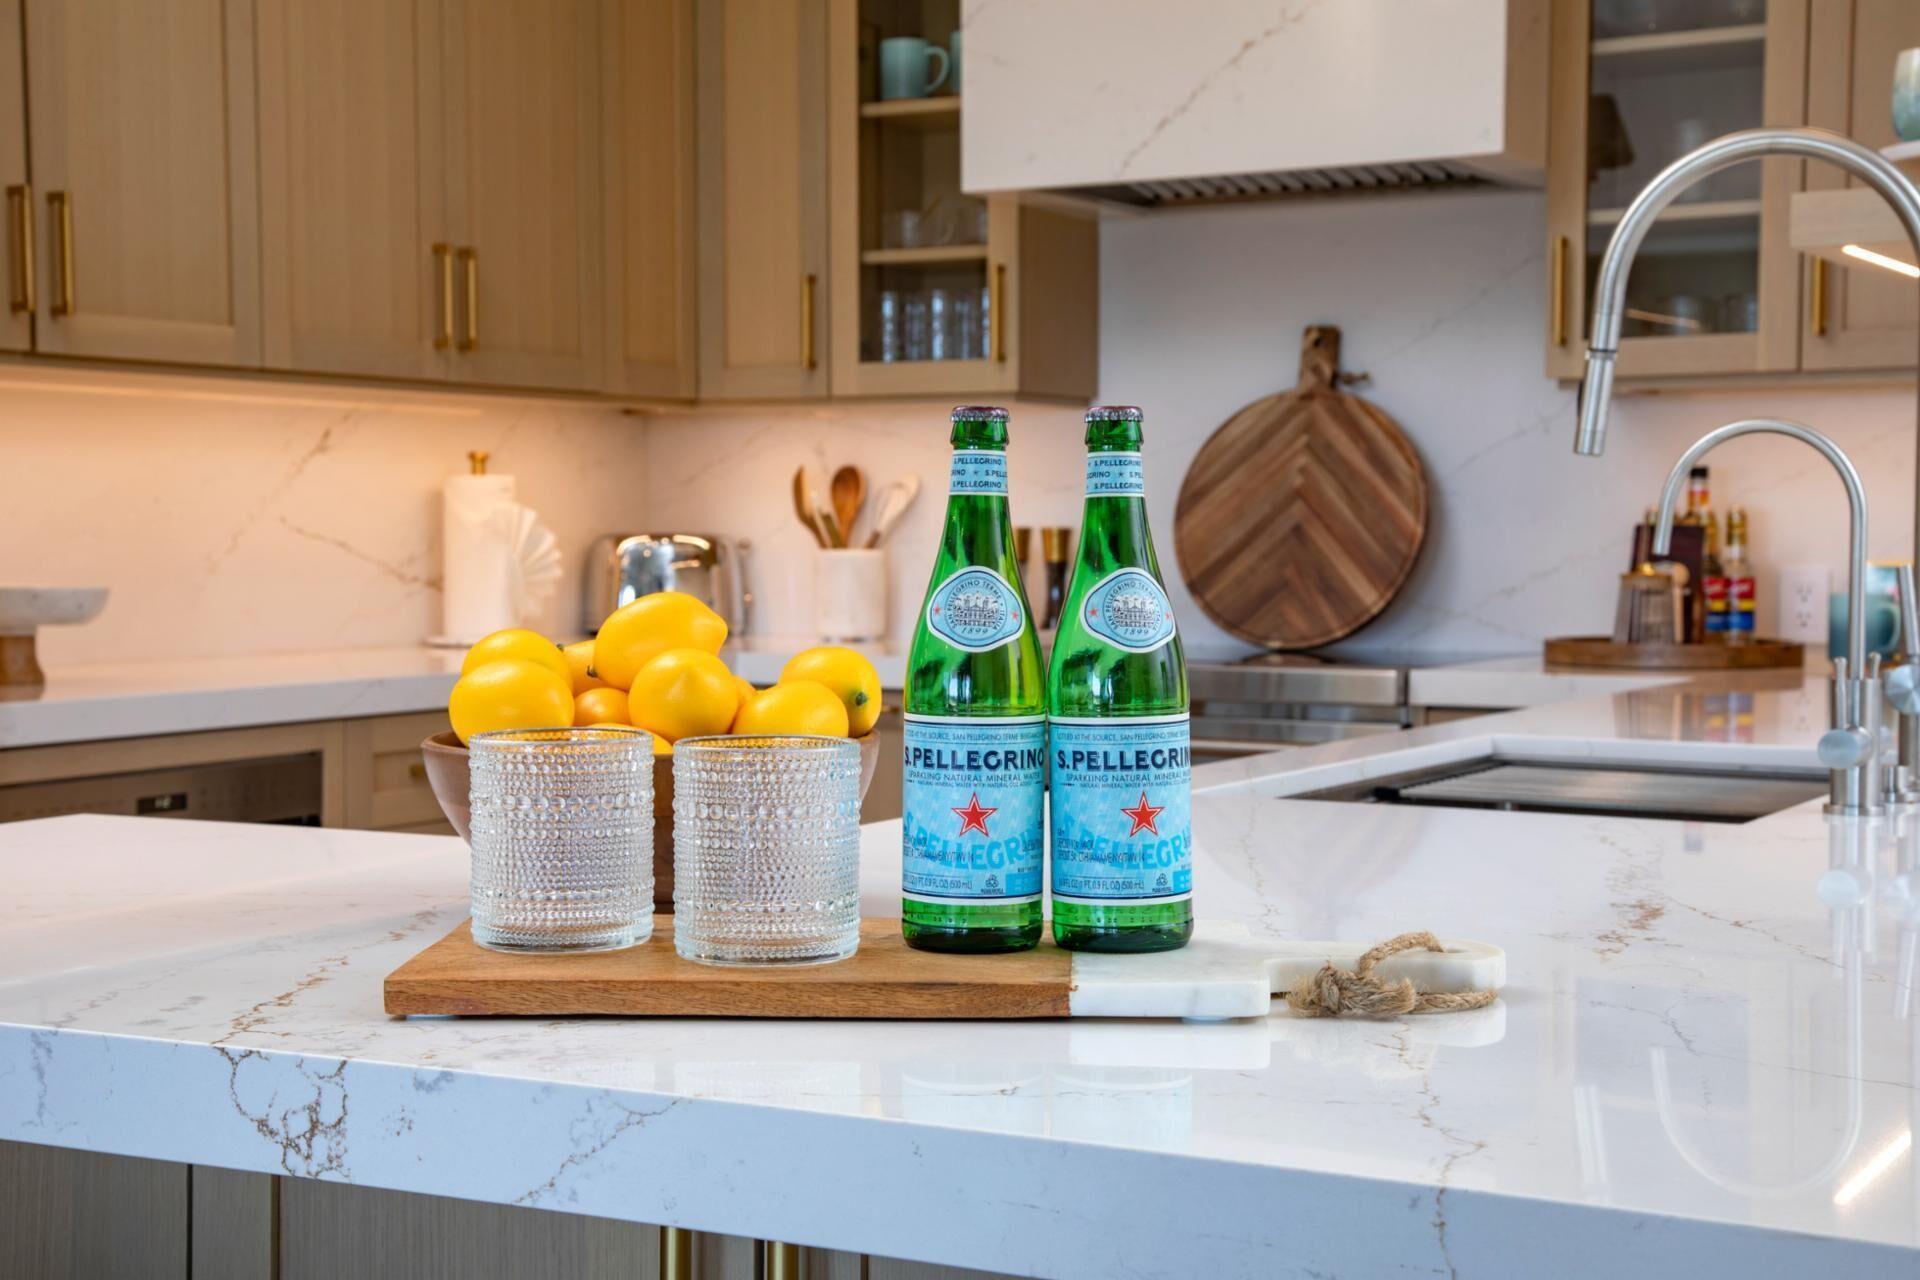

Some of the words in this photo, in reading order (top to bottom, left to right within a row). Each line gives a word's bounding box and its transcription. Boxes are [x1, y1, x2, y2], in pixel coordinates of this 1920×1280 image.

[905, 746, 1044, 770] S.PELLEGRINO
[944, 772, 982, 782] NATURAL
[987, 773, 1022, 782] MINERAL
[1066, 772, 1109, 782] SPARKLING
[1112, 773, 1151, 782] NATURAL
[1154, 771, 1183, 781] MINERAL
